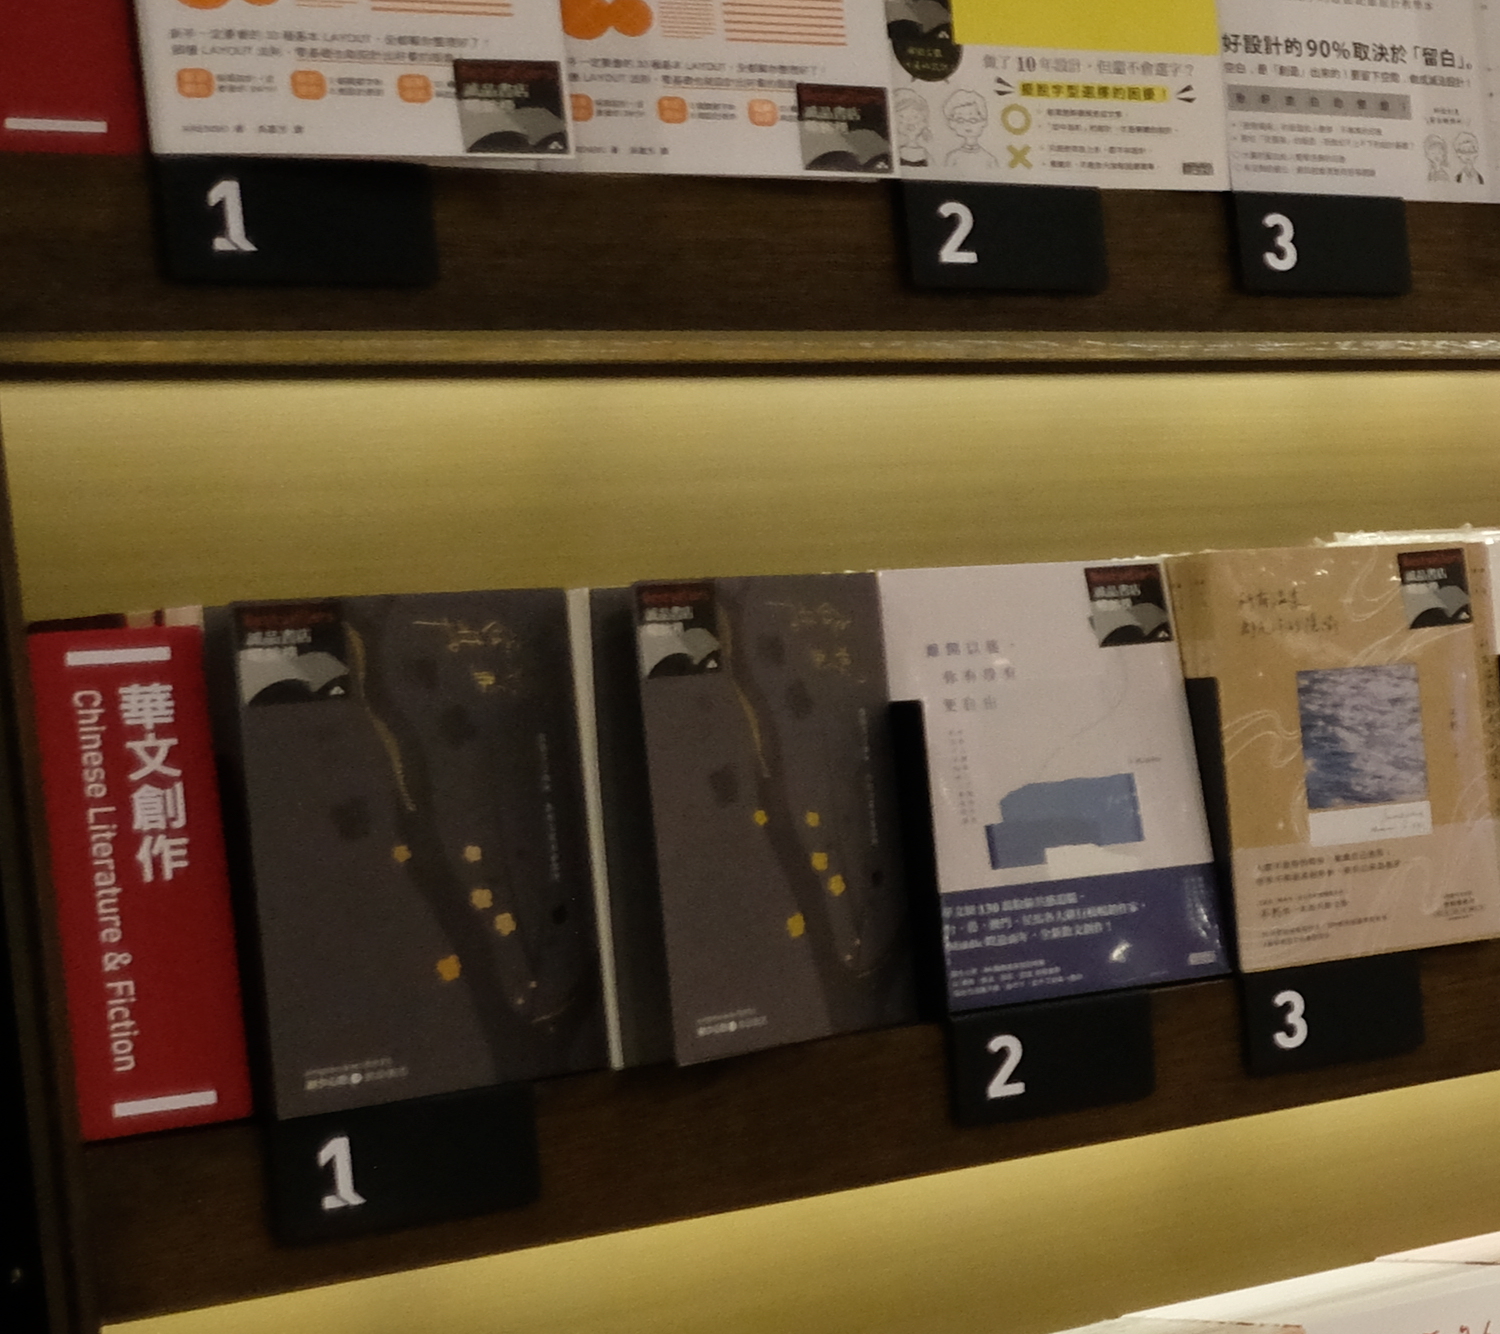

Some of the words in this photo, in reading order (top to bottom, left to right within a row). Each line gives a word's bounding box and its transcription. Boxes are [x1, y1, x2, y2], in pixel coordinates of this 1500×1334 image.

[205, 177, 259, 254] 1
[936, 201, 979, 266] 2
[1262, 213, 1298, 271] 3
[71, 688, 107, 788] Chinese
[118, 681, 190, 884] 華文創作
[83, 791, 122, 943] Literature
[101, 949, 122, 973] &
[104, 979, 139, 1073] Fiction
[1272, 990, 1309, 1051] 3
[985, 1034, 1027, 1101] 2
[316, 1134, 366, 1211] 1
